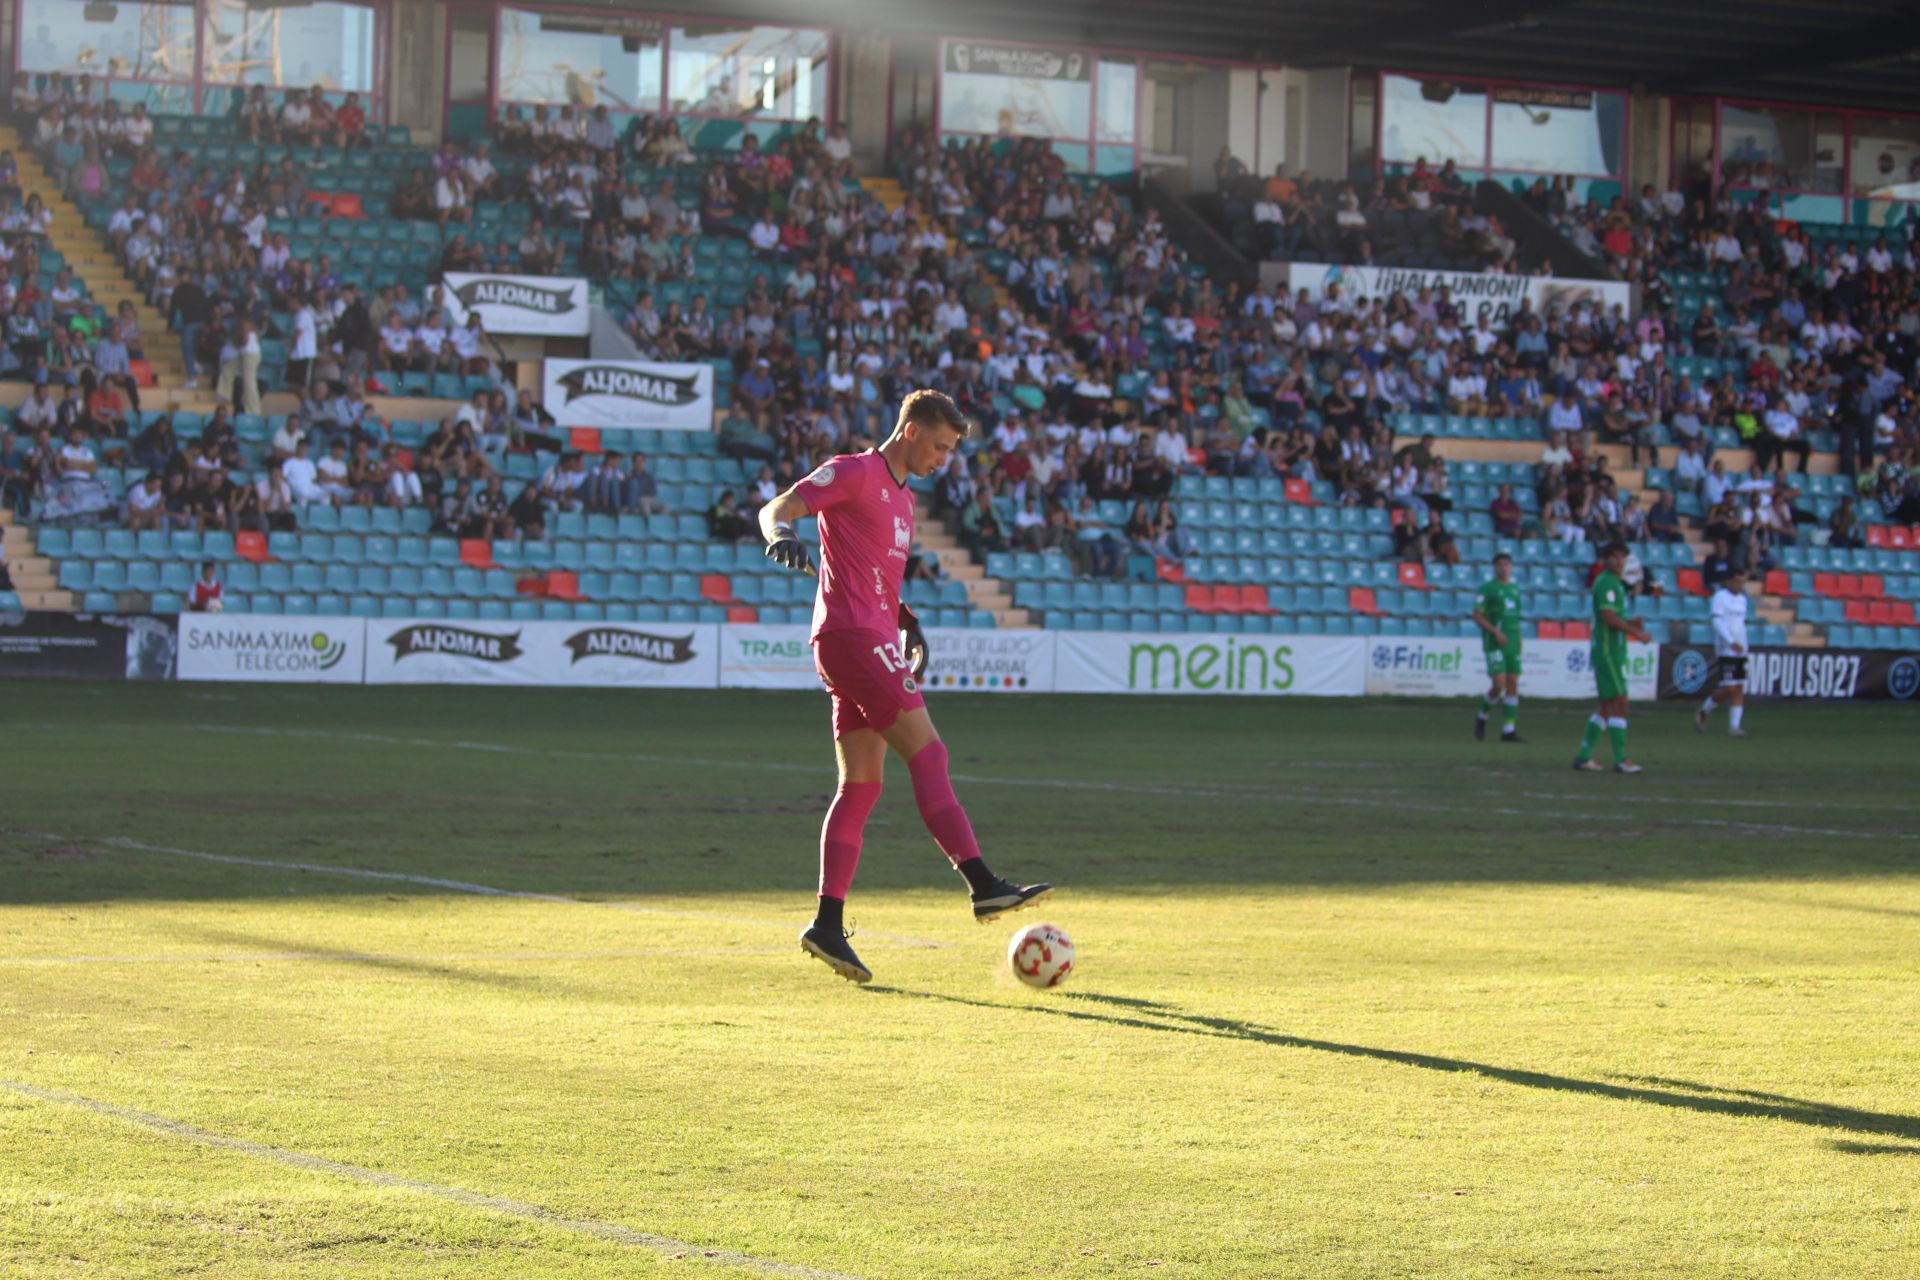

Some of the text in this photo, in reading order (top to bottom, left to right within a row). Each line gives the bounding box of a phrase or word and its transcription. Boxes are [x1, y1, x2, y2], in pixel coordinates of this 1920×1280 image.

[475, 283, 557, 311] ALJOMAR
[583, 370, 678, 402] ALJOMAR
[187, 628, 329, 652] SANMAXIMO
[411, 629, 501, 659] ALJOMAR
[587, 632, 675, 661] ALJOMAR
[234, 652, 319, 671] TELECOM
[873, 642, 906, 673] 13
[929, 657, 1027, 673] MPRESARIAL
[1128, 636, 1295, 690] meins
[1394, 645, 1463, 672] Frinet
